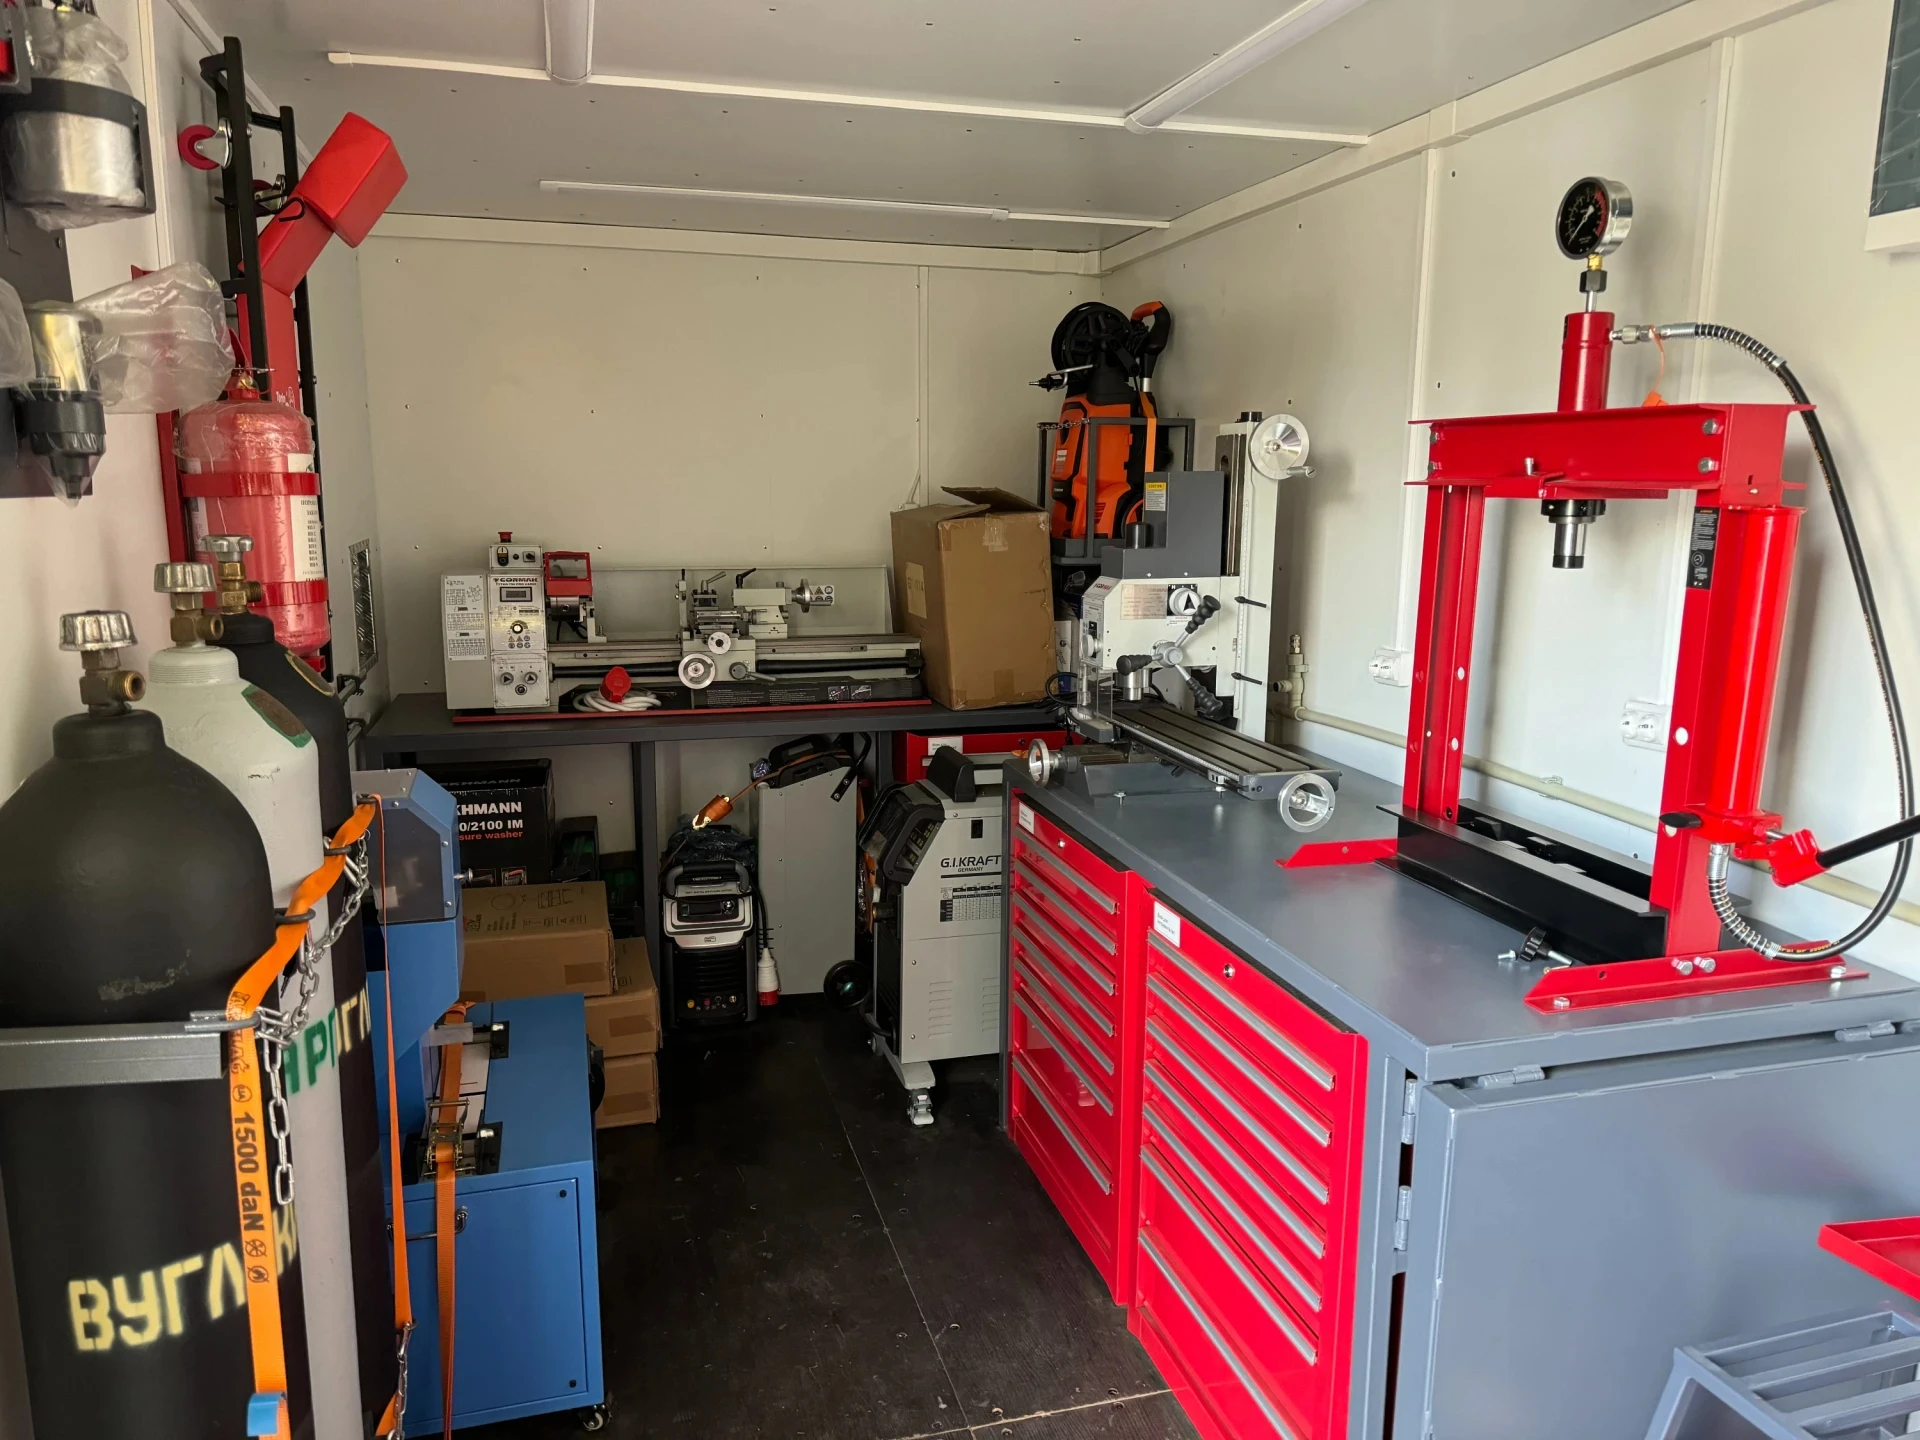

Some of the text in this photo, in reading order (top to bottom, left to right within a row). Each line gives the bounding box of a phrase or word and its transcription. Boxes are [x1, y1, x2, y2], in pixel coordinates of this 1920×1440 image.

[507, 819, 523, 829] IM
[459, 830, 523, 841] sure washer
[940, 854, 1002, 868] G.I.KRAFT
[233, 1111, 265, 1232] 1500 daN
